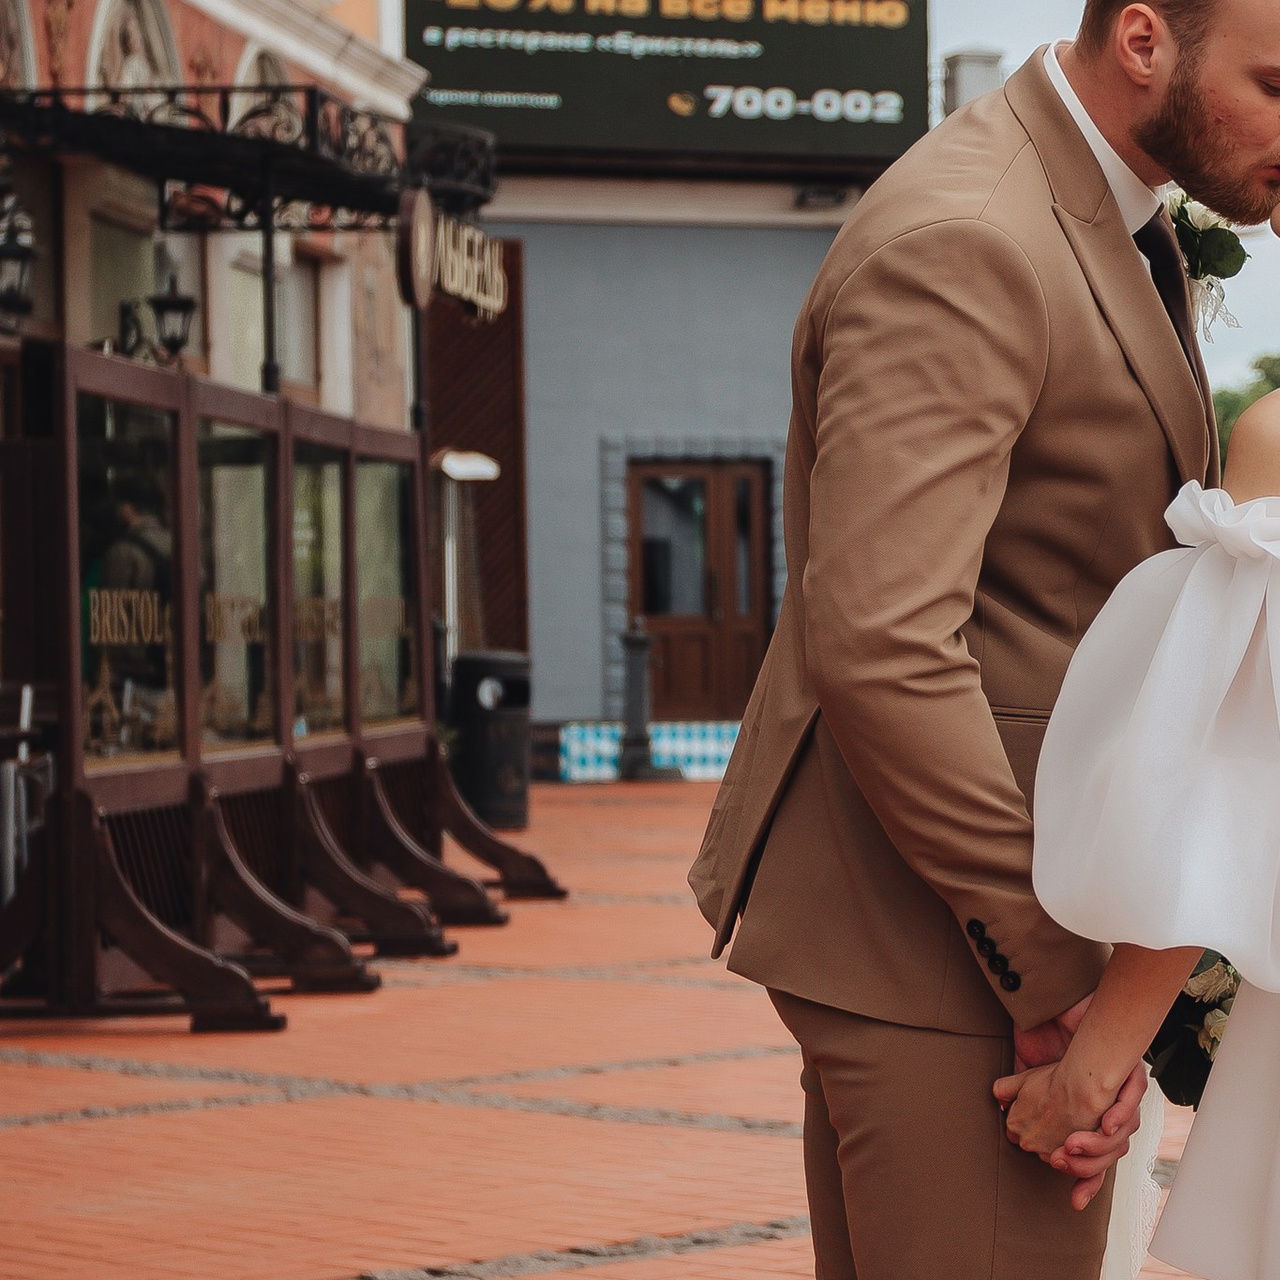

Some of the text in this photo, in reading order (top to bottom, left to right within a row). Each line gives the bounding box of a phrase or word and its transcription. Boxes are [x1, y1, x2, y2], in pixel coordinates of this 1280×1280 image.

[445, 26, 594, 55] ресторане
[703, 84, 905, 124] 700-002
[89, 588, 165, 646] BRISTOL
